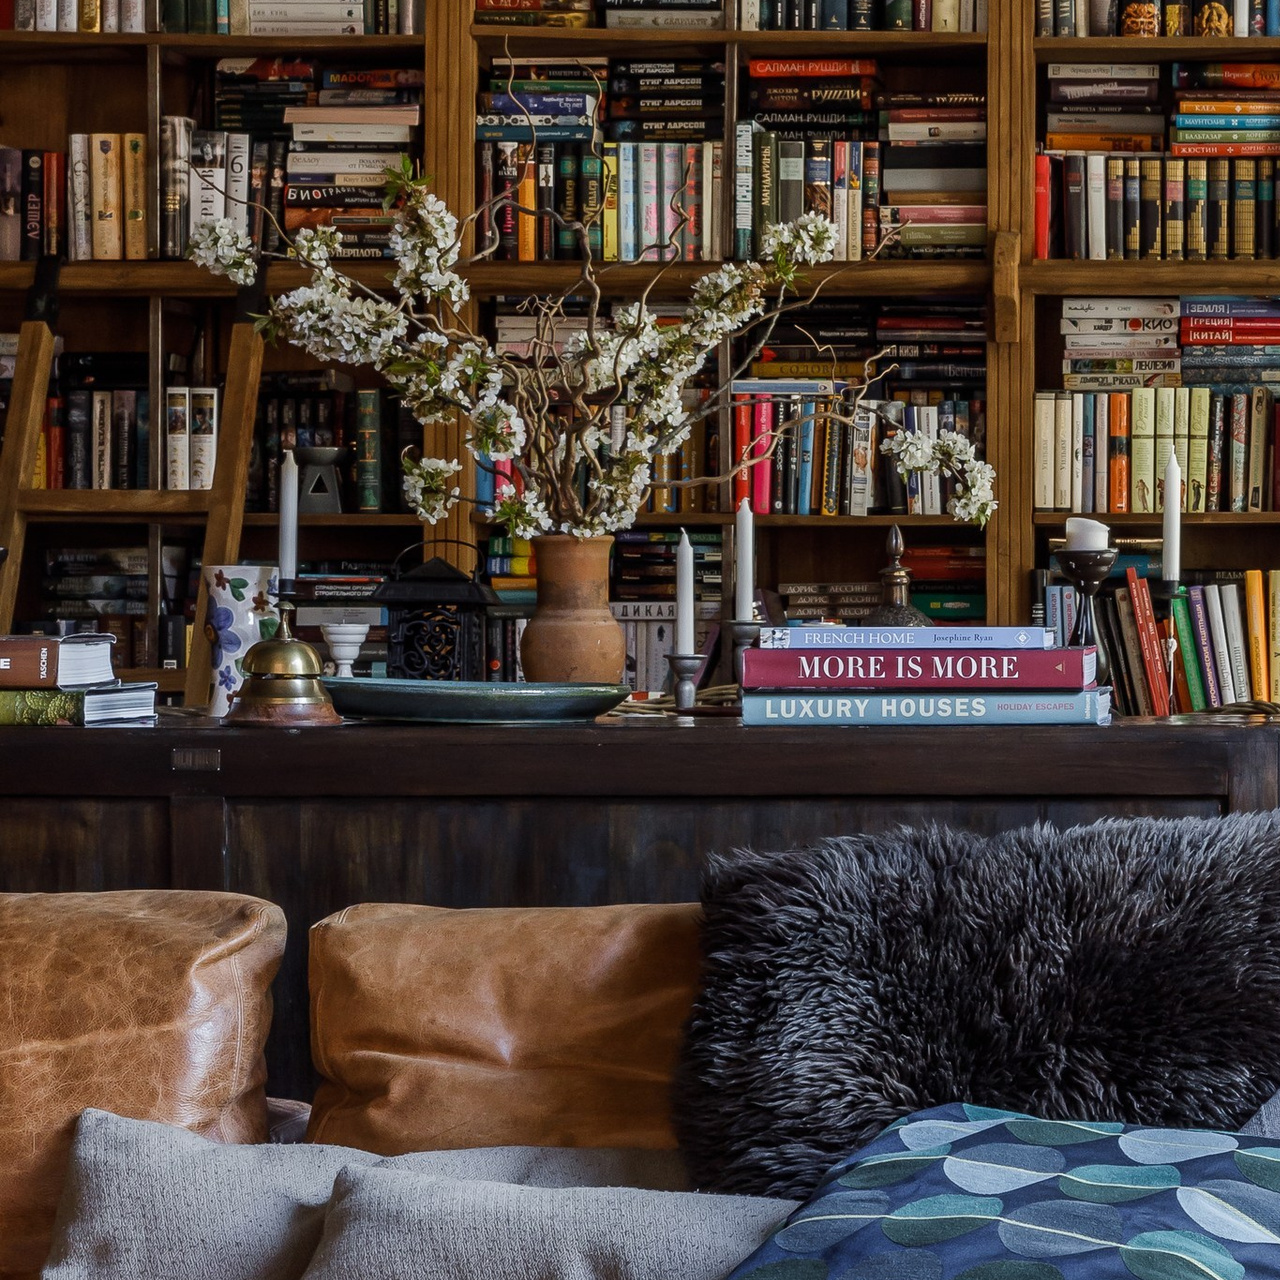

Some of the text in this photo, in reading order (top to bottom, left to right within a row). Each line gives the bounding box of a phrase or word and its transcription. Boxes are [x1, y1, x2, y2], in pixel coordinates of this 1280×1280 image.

[756, 62, 848, 73] САЛМАН РУШДИ
[640, 78, 662, 86] СТИГ
[812, 89, 861, 104] РУШДИ
[640, 99, 662, 107] СТИГ
[754, 113, 846, 123] САЛМАН РУШДИ
[1184, 118, 1226, 126] МАУНТОЛИВ
[643, 122, 665, 130] СТИГ
[761, 145, 772, 206] МАНДАРИНЫ
[26, 193, 40, 240] ЛЭШЕР
[1135, 360, 1176, 371] ЛЕКЛЕЗИО
[1112, 376, 1141, 385] PRADA
[1211, 463, 1219, 487] Байетт
[786, 585, 869, 594] ДОРИС ЛЕССИНГ
[798, 596, 829, 604] ДОРИС
[795, 607, 827, 616] ДОРИС
[1195, 604, 1207, 645] РЕЦЕПТЫШИ
[804, 631, 915, 645] FRENCH HOME
[932, 632, 994, 644] Josephine Ryan
[39, 647, 48, 680] TASCHEN
[797, 655, 1020, 680] MORE IS MORE
[1233, 646, 1247, 699] Рецептыши
[765, 697, 1075, 719] LUXURY HOUSES HOLIDAY ESCAPES
